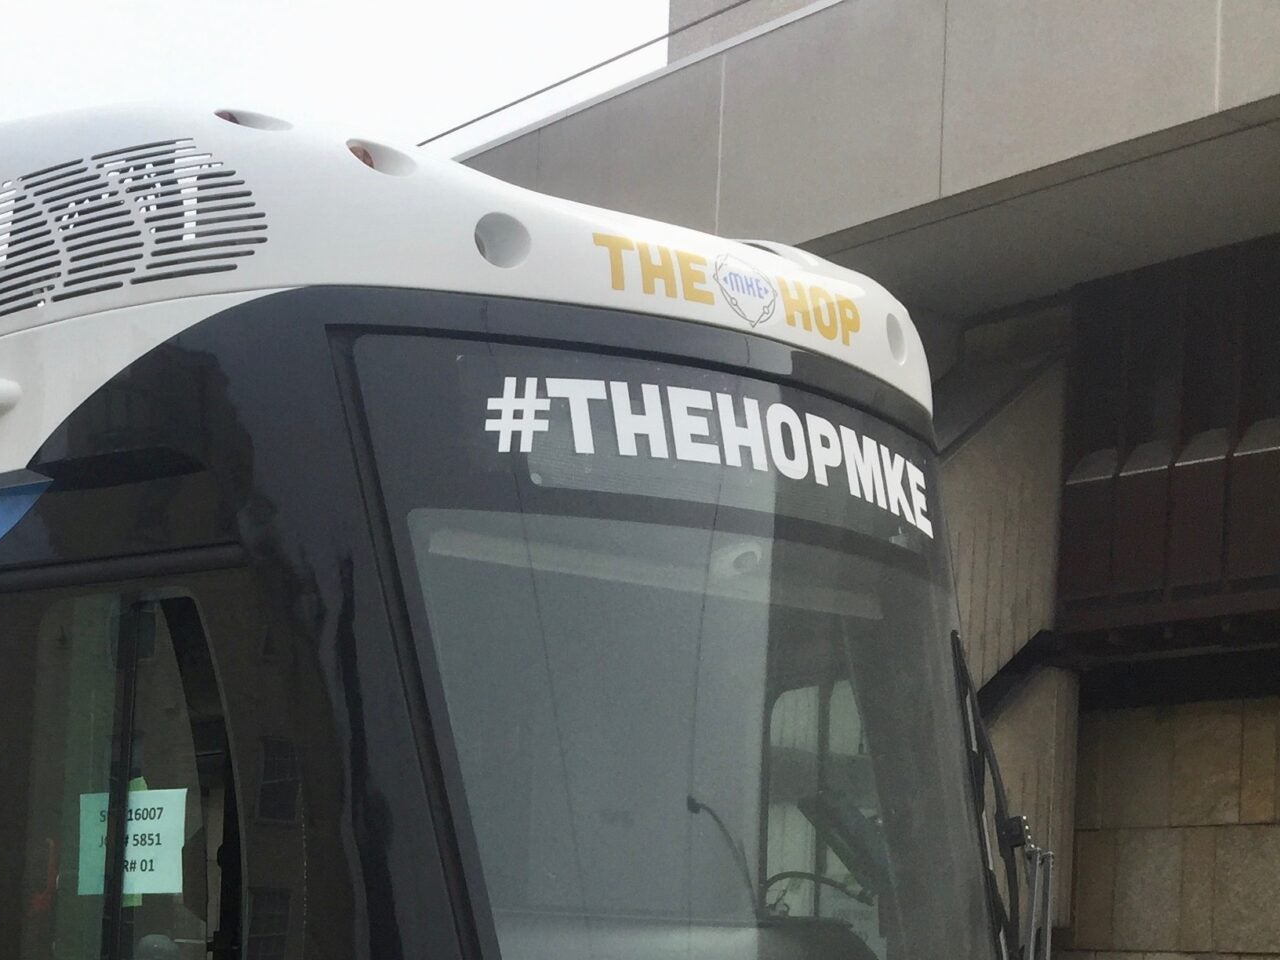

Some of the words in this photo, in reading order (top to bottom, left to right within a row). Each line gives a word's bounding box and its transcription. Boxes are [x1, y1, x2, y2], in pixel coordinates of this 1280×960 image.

[593, 233, 715, 305] THE
[779, 276, 861, 346] HOP
[728, 271, 765, 300] MKE
[485, 376, 934, 539] #THEHOPMKE
[127, 807, 163, 821] 16007
[132, 833, 162, 847] 5851
[140, 859, 154, 872] 01
